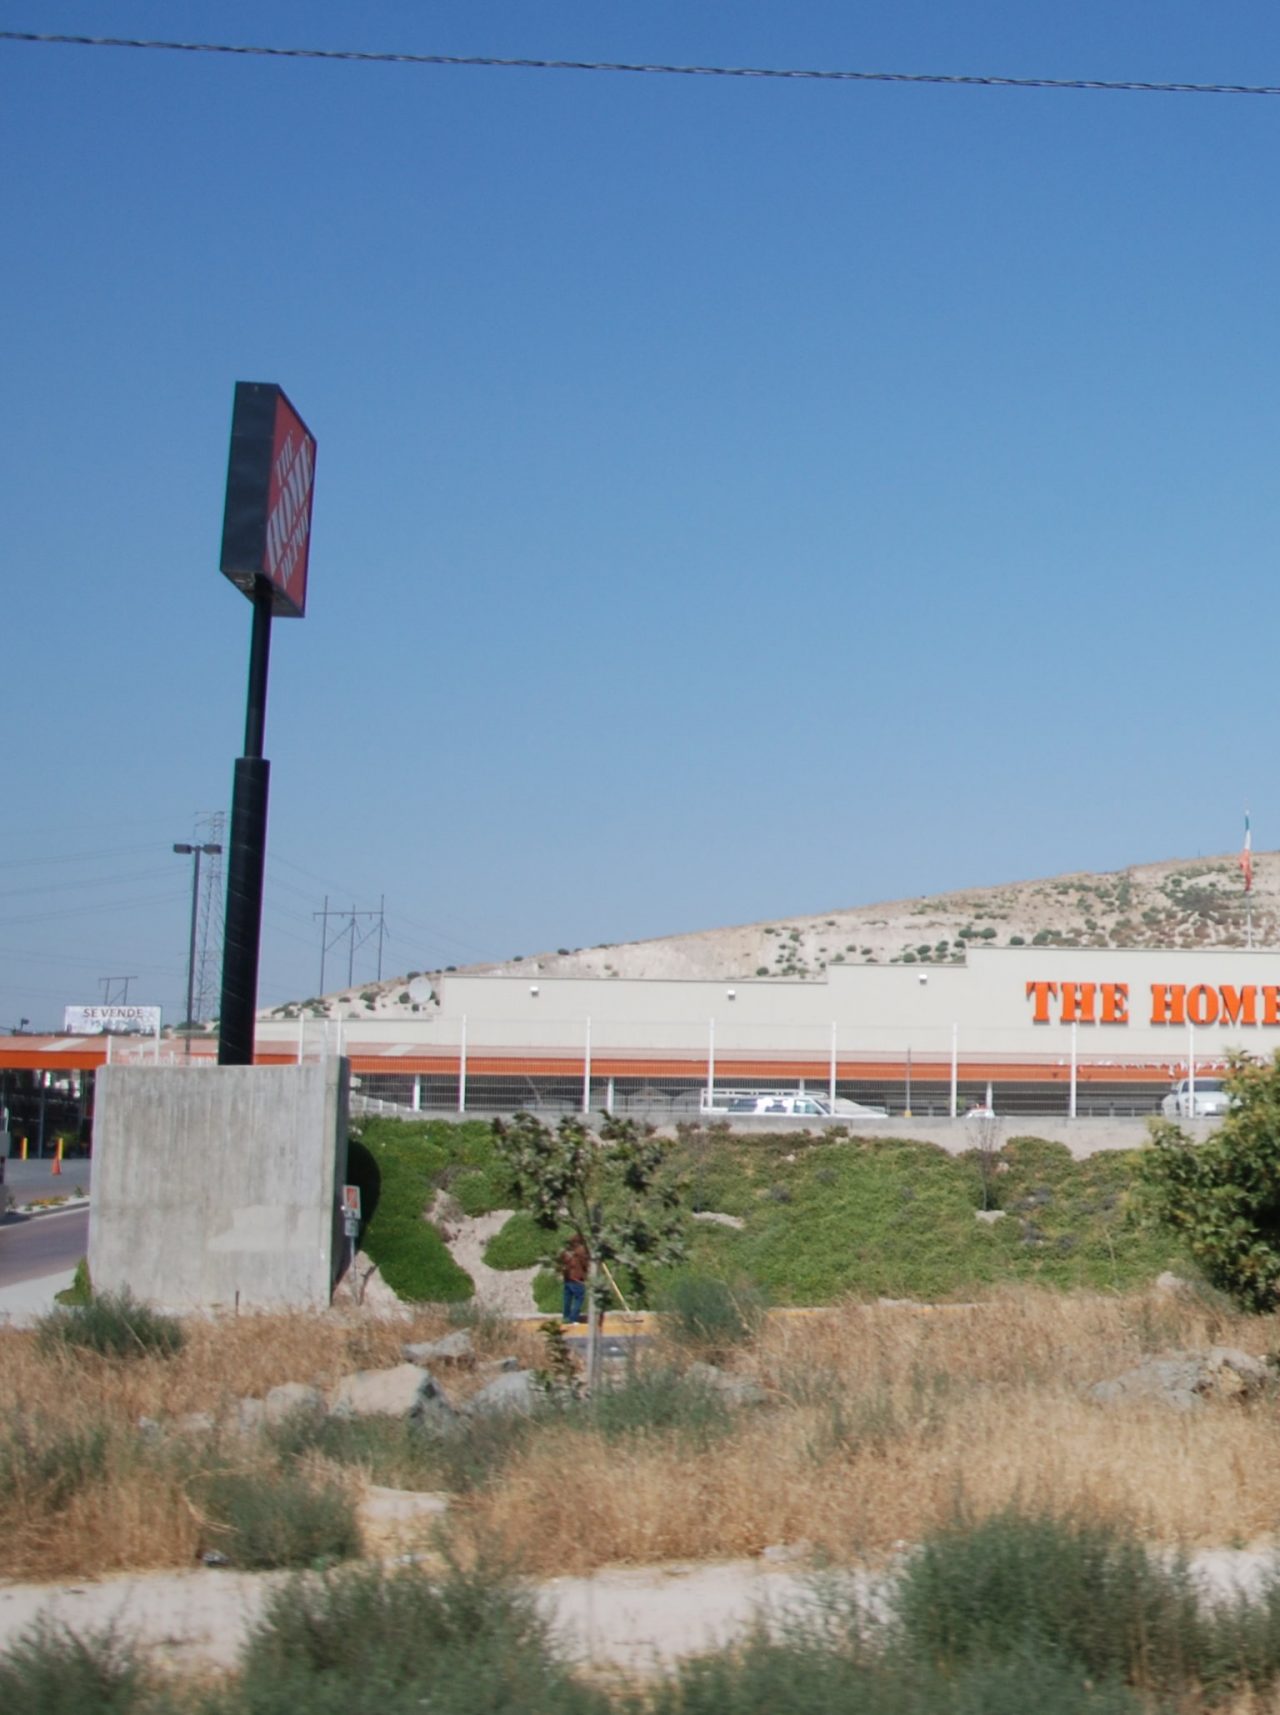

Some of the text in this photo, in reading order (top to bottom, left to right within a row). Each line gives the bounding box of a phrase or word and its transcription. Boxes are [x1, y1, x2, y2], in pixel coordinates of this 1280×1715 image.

[83, 1008, 144, 1018] SE VENDE
[1026, 981, 1129, 1025] THE
